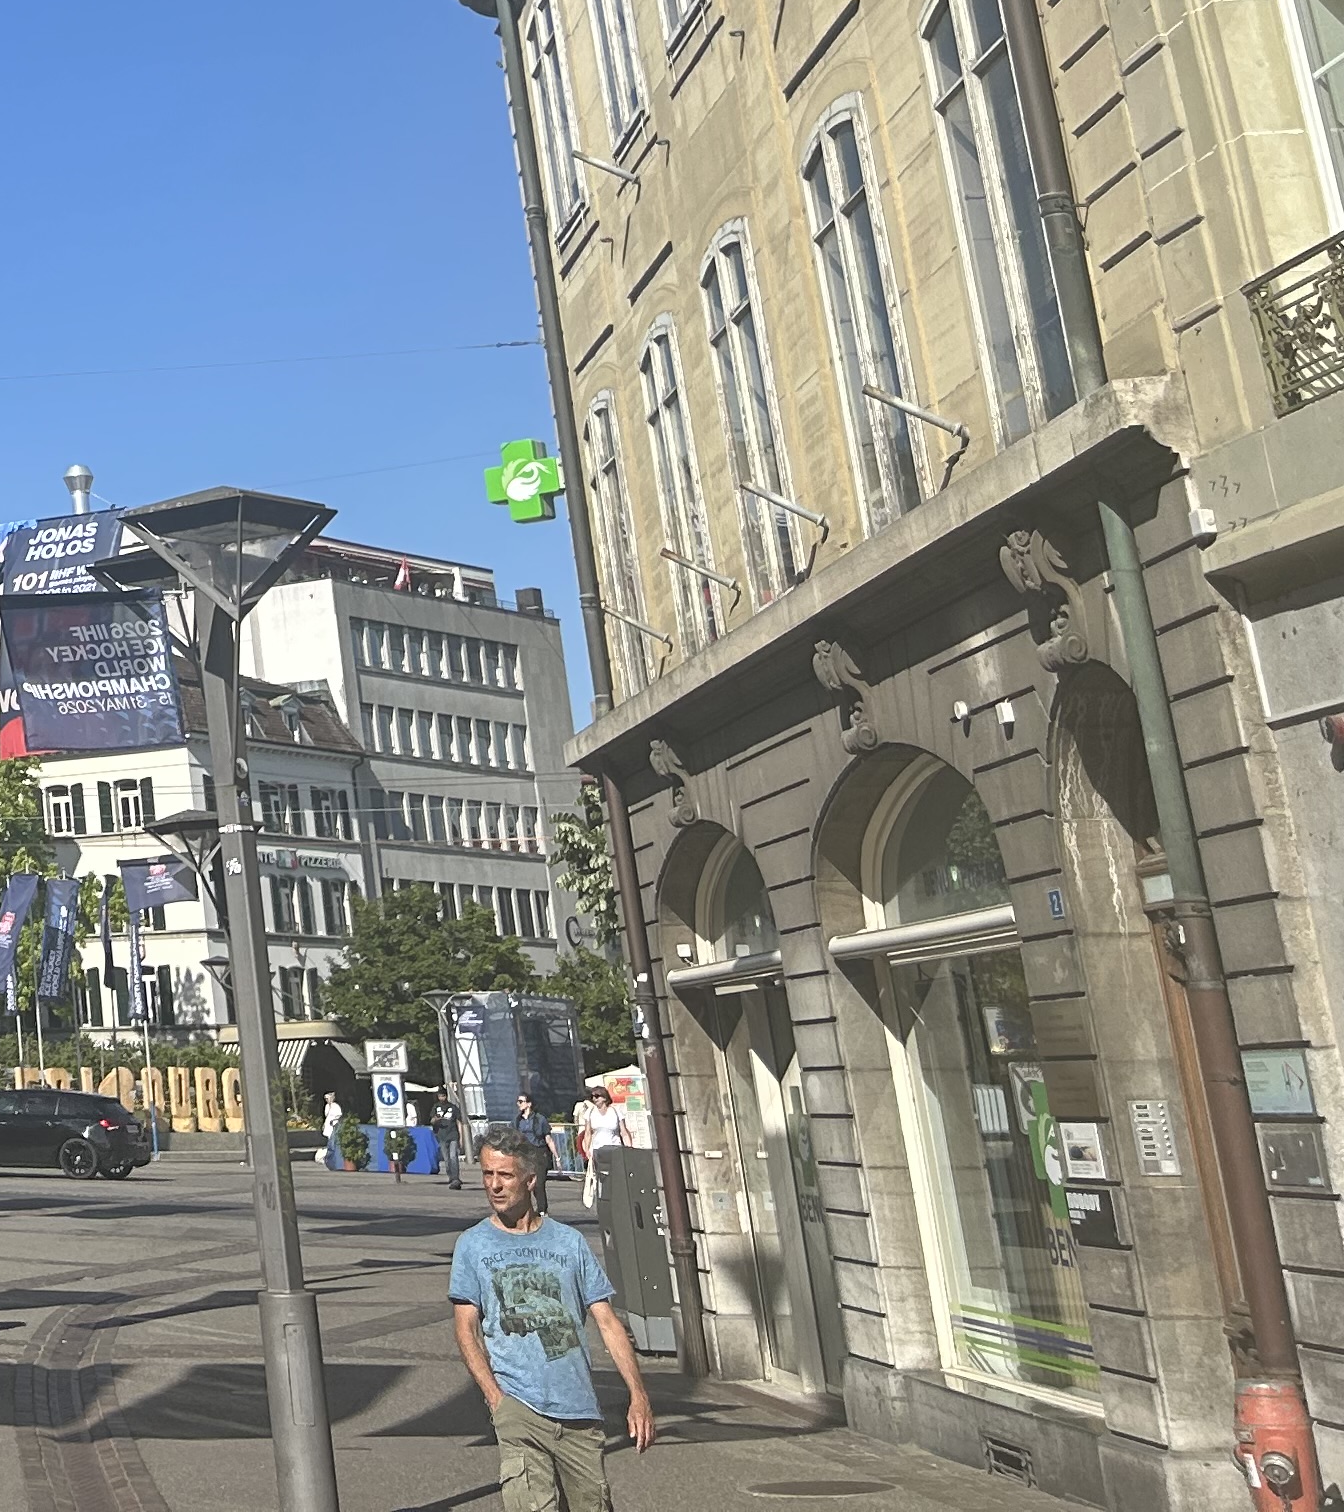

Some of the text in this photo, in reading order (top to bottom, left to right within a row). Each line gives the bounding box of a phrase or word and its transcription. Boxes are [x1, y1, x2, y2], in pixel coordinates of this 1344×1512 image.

[28, 521, 99, 545] JONAS
[24, 537, 96, 562] HOLOS
[12, 570, 49, 593] 101
[1052, 894, 1061, 912] 2
